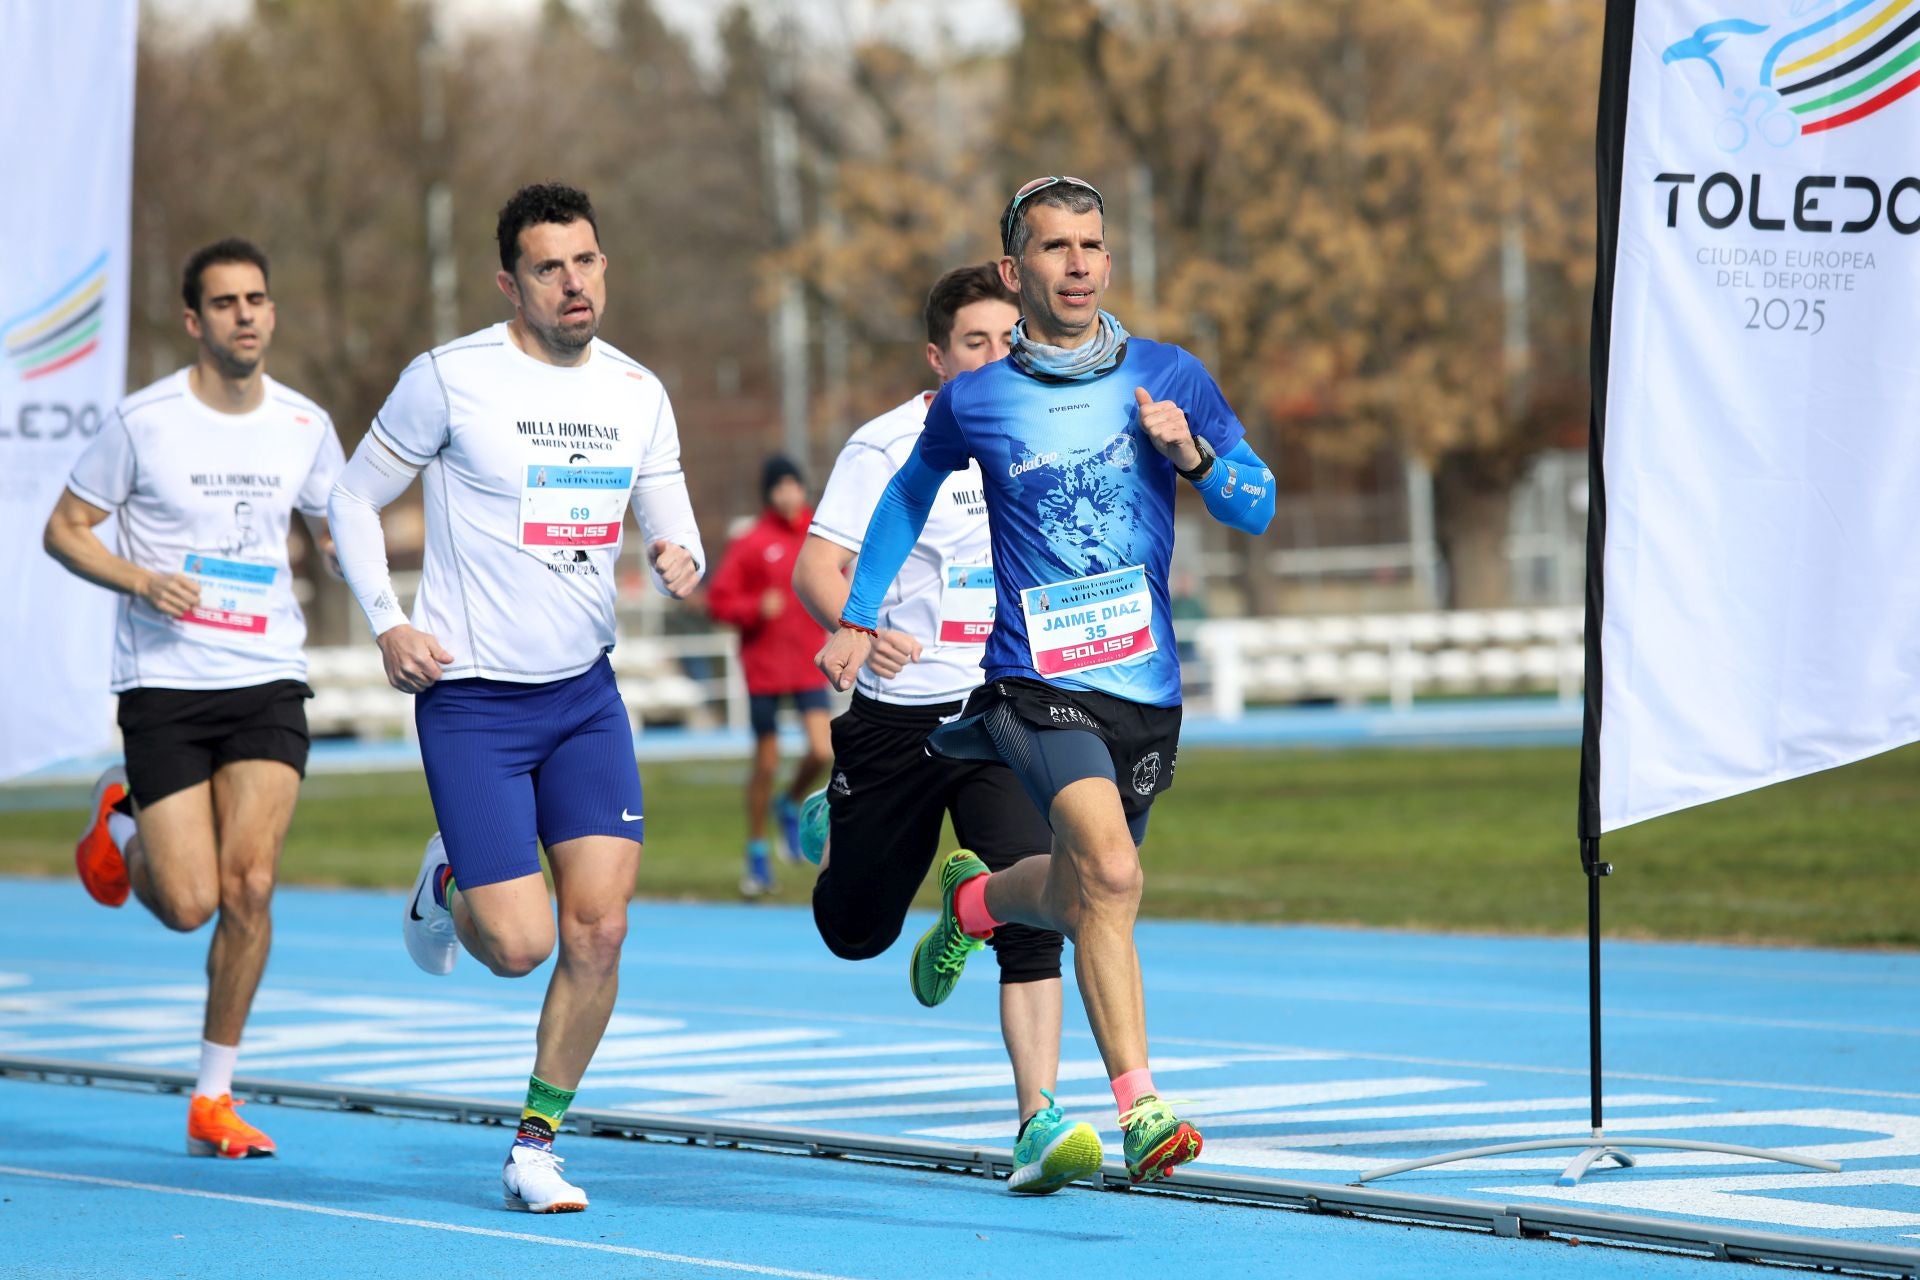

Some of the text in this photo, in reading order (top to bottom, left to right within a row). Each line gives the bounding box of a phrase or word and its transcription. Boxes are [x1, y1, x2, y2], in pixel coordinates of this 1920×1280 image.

[1654, 171, 1920, 235] TOLEDO
[1696, 247, 1876, 270] CIUDAD EUROPEA
[1716, 270, 1855, 291] DEL DEPORTE
[1744, 297, 1826, 335] 2025
[517, 421, 621, 442] MILLA HOMENAJE
[570, 441, 613, 451] VELASCO
[570, 507, 590, 521] 69
[1099, 582, 1136, 596] VELASCO
[193, 607, 254, 628] SOLISS
[1042, 600, 1141, 631] JAIME DIAZ
[1084, 624, 1107, 641] 35
[1061, 636, 1134, 661] SOLISS
